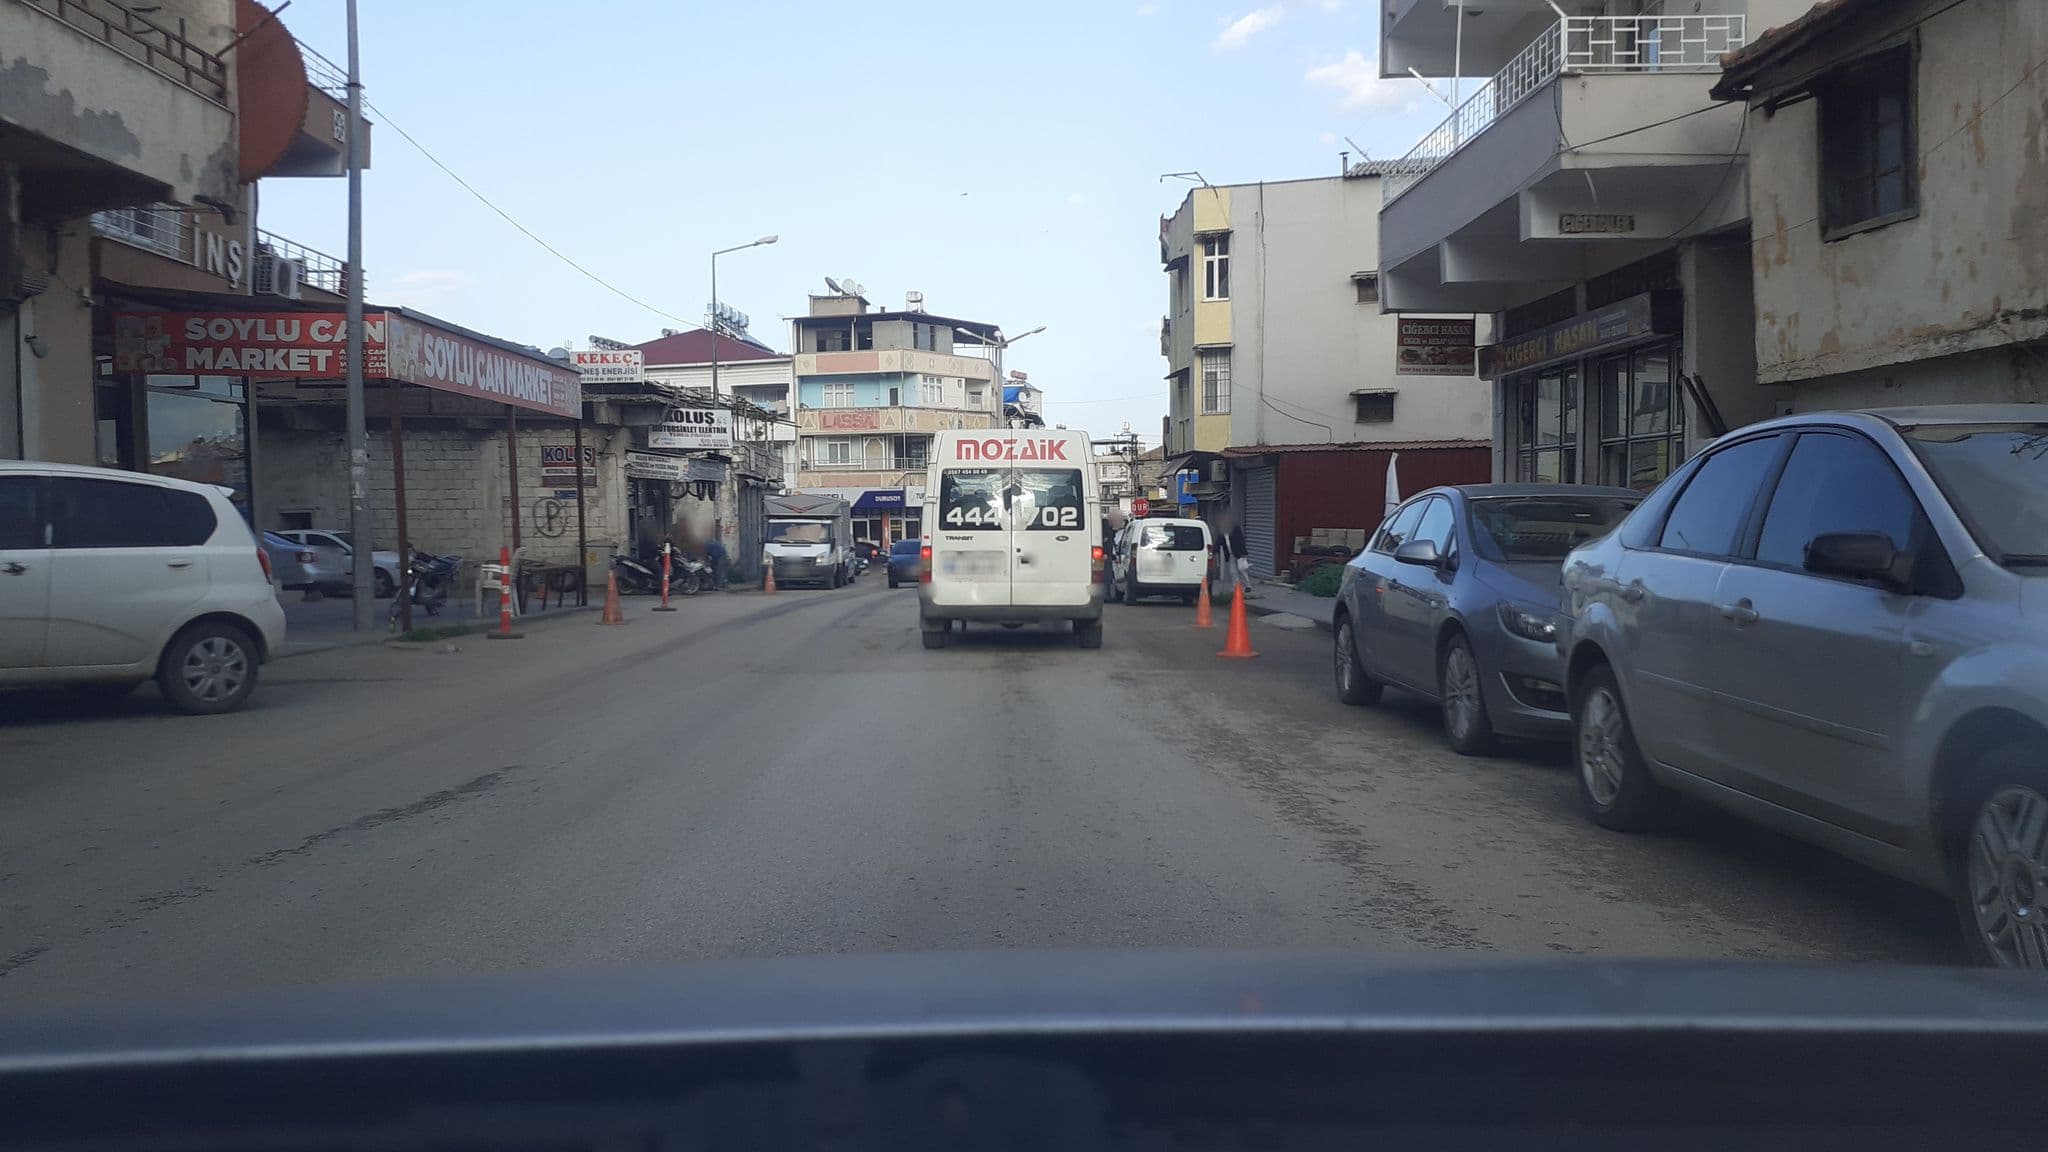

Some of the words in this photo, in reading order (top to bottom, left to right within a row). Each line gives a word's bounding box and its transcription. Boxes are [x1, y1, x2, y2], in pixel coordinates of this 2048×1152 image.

[184, 318, 301, 343] SOYLU
[308, 318, 385, 343] CAN
[1441, 324, 1472, 335] HASAN
[1554, 319, 1599, 353] HASAN
[184, 348, 333, 372] MARKET
[423, 332, 474, 388] SOYLU
[476, 350, 505, 395] CAN
[506, 358, 552, 406] MARKET
[583, 367, 599, 376] NEŞ
[822, 413, 874, 429] LASSA
[543, 447, 593, 465] KOLŞ
[1132, 503, 1148, 512] DUR
